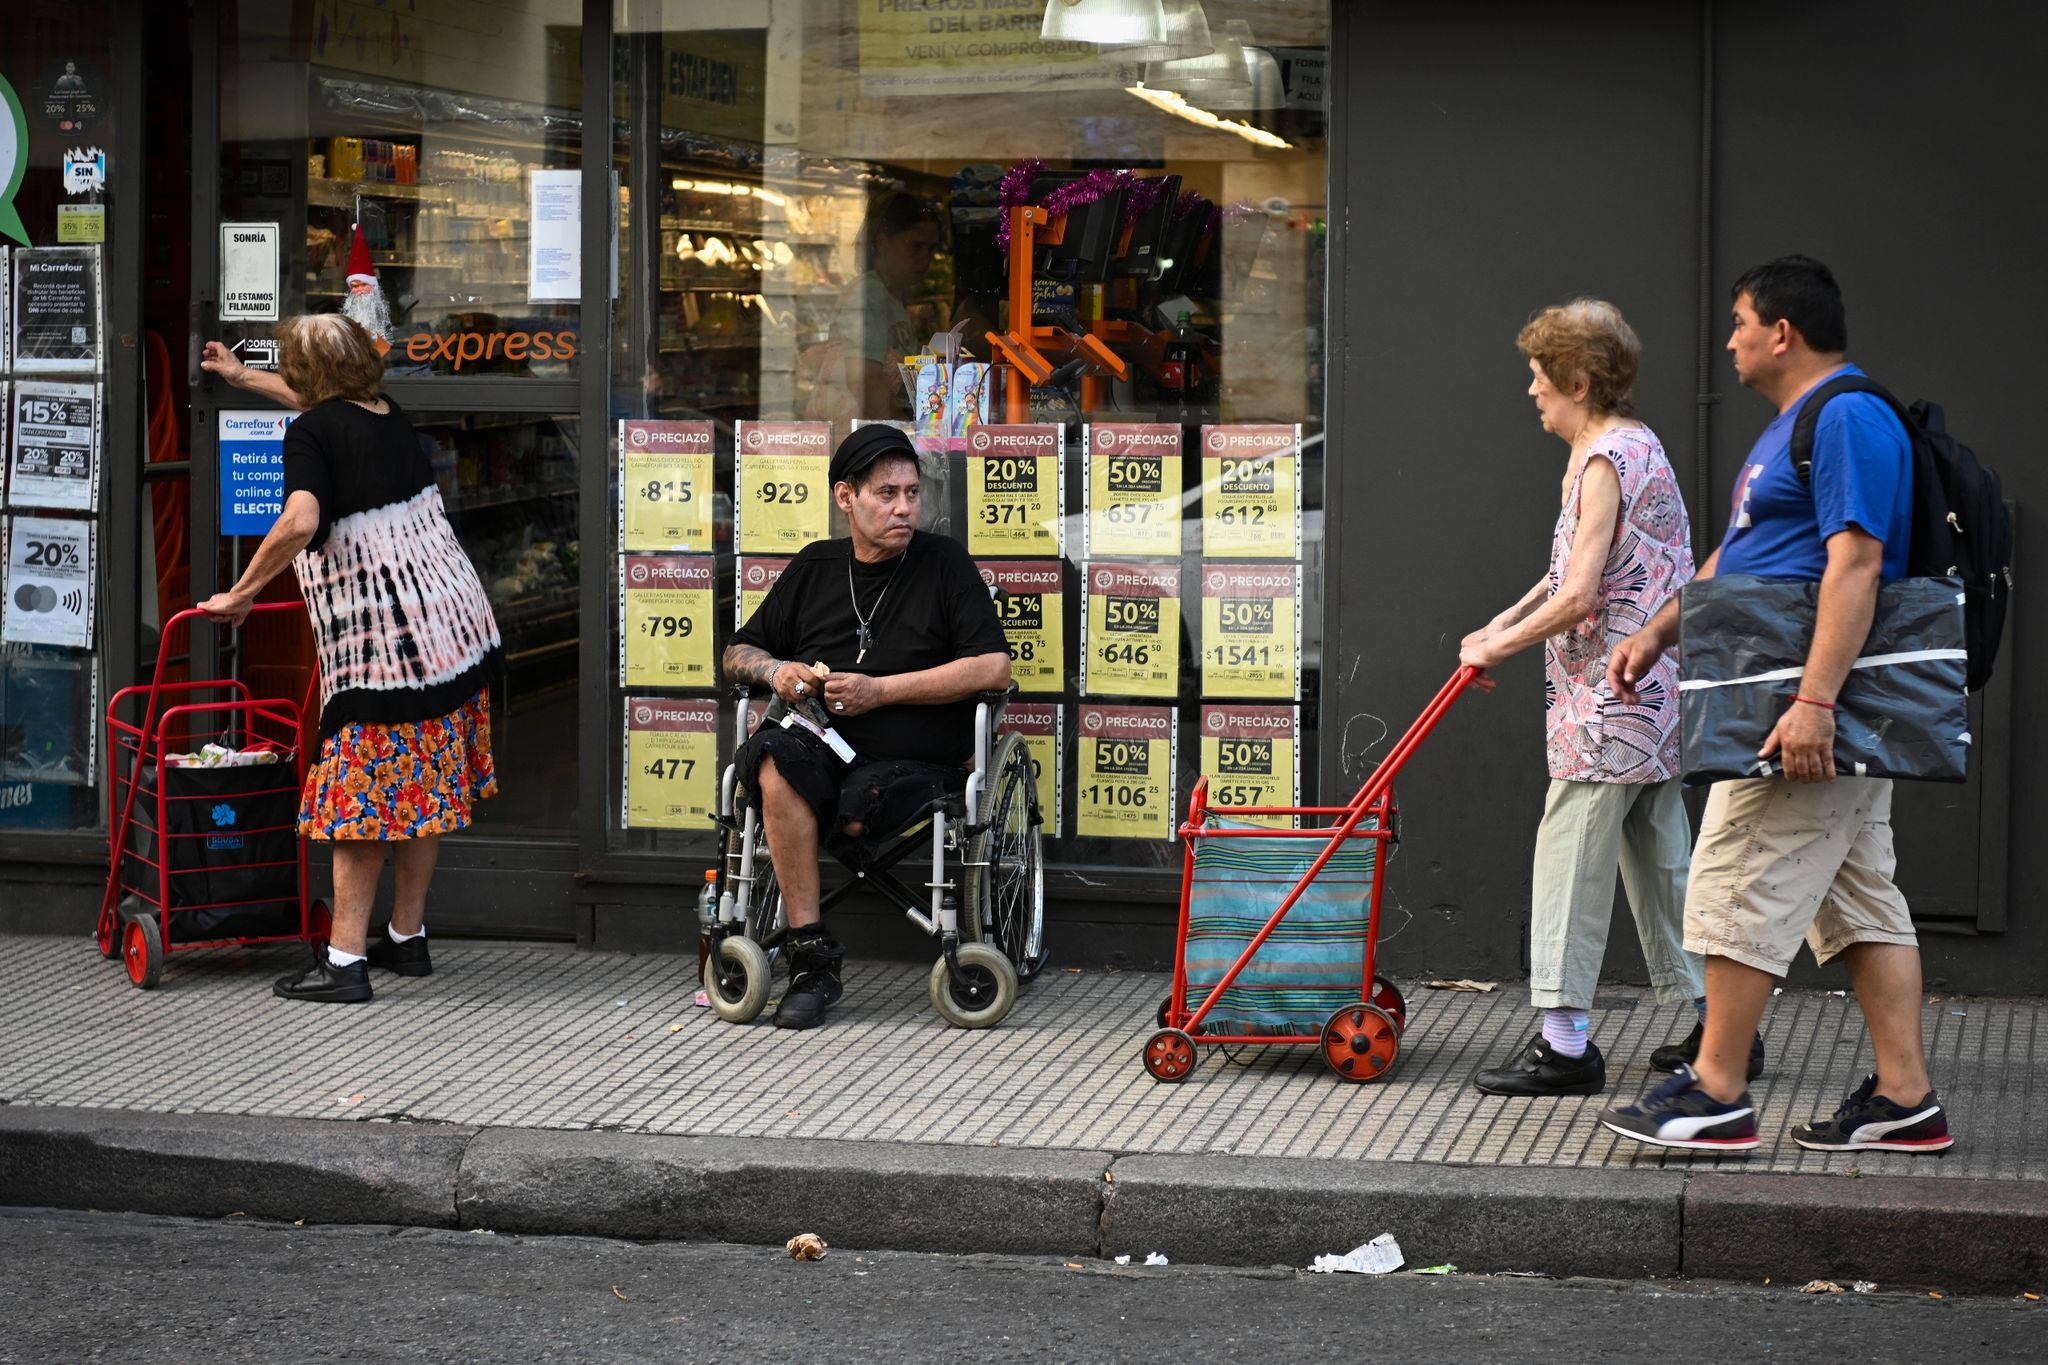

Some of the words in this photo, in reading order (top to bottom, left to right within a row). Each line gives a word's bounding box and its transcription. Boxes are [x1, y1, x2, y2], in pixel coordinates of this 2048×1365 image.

[929, 15, 971, 34] DEL
[979, 14, 1043, 32] BARR
[905, 41, 946, 60] VENÍ
[951, 44, 962, 57] Y
[967, 40, 1091, 58] COMPROBALO
[75, 167, 93, 177] SIN
[233, 232, 266, 243] SONRÍA
[29, 264, 40, 272] Mi
[40, 263, 83, 272] Carrefour
[226, 293, 236, 301] LO
[238, 293, 273, 301] ESTAMOS
[228, 302, 271, 311] FILMANDO
[406, 330, 577, 371] express
[20, 400, 67, 424] 15%
[225, 418, 275, 429] Carrefour
[651, 433, 710, 443] PRECIAZO
[767, 434, 827, 445] PRECIAZO
[993, 435, 1054, 446] PRECIAZO
[1118, 434, 1178, 445] PRECIAZO
[1230, 436, 1291, 446] PRECIAZO
[24, 448, 49, 460] 20%
[60, 450, 85, 463] 20%
[232, 452, 268, 464] Retirá
[986, 459, 1035, 481] 20%
[1109, 461, 1160, 484] 50%
[1222, 460, 1272, 482] 20%
[232, 471, 245, 481] tu
[247, 472, 284, 483] compr
[235, 486, 271, 498] online
[274, 486, 285, 498] d
[640, 480, 692, 503] $815
[987, 482, 1033, 490] DESCUENTO
[1223, 483, 1270, 491] DESCUENTO
[756, 482, 809, 504] $929
[234, 503, 282, 514] ELECTR
[979, 504, 1026, 524] $371
[1031, 503, 1041, 511] 20
[1102, 503, 1152, 524] $657
[1155, 503, 1165, 511] 75
[1215, 505, 1265, 526] $612
[24, 541, 79, 567] 20%
[651, 568, 710, 579] PRECIAZO
[998, 572, 1059, 583] PRECIAZO
[1116, 575, 1177, 587] PRECIAZO
[1230, 576, 1291, 587] PRECIAZO
[993, 596, 1040, 618] 15%
[1107, 601, 1157, 624] 50%
[1221, 603, 1271, 626] 50%
[641, 616, 693, 638] $799
[1000, 619, 1039, 627] SCUENTO
[1036, 640, 1046, 648] 75
[1098, 643, 1149, 665] $646
[1151, 644, 1162, 652] 50
[1206, 645, 1269, 666] $1541
[1274, 644, 1285, 652] 25
[655, 710, 714, 722] PRECIAZO
[1000, 714, 1052, 725] RECIAZO
[1229, 716, 1290, 728] PRECIAZO
[1106, 716, 1167, 729] PRECIAZO
[1097, 743, 1147, 766] 50%
[1220, 743, 1270, 766] 50%
[644, 758, 696, 780] $477
[1081, 785, 1147, 807] $1106
[1148, 785, 1159, 794] 25
[1212, 785, 1263, 806] $657
[1265, 785, 1275, 793] 75
